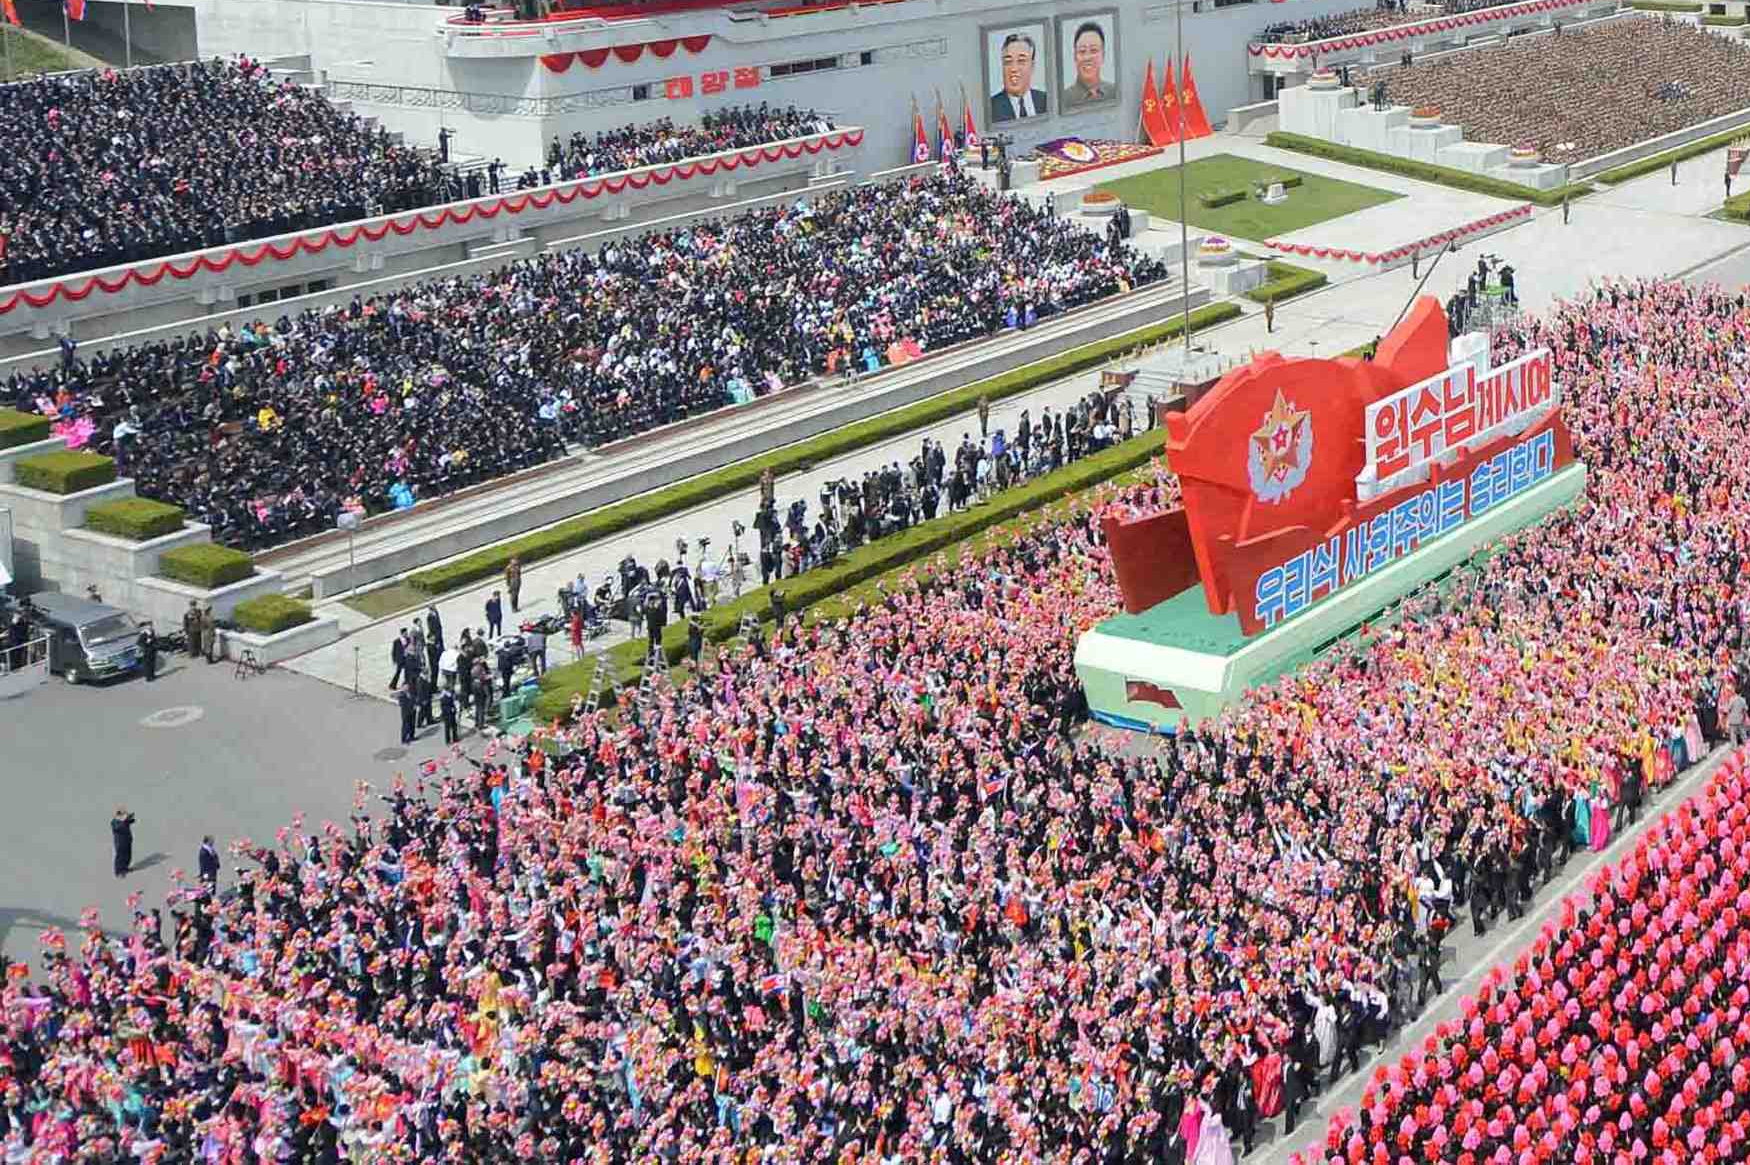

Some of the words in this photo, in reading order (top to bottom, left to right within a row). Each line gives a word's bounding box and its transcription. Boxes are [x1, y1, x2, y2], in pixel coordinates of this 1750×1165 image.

[1374, 366, 1476, 482] 원수님
[1476, 353, 1550, 432] 계시여
[1254, 534, 1340, 630] 우리식
[1343, 478, 1465, 581] 사회주의는
[1469, 428, 1554, 516] 승리한다
